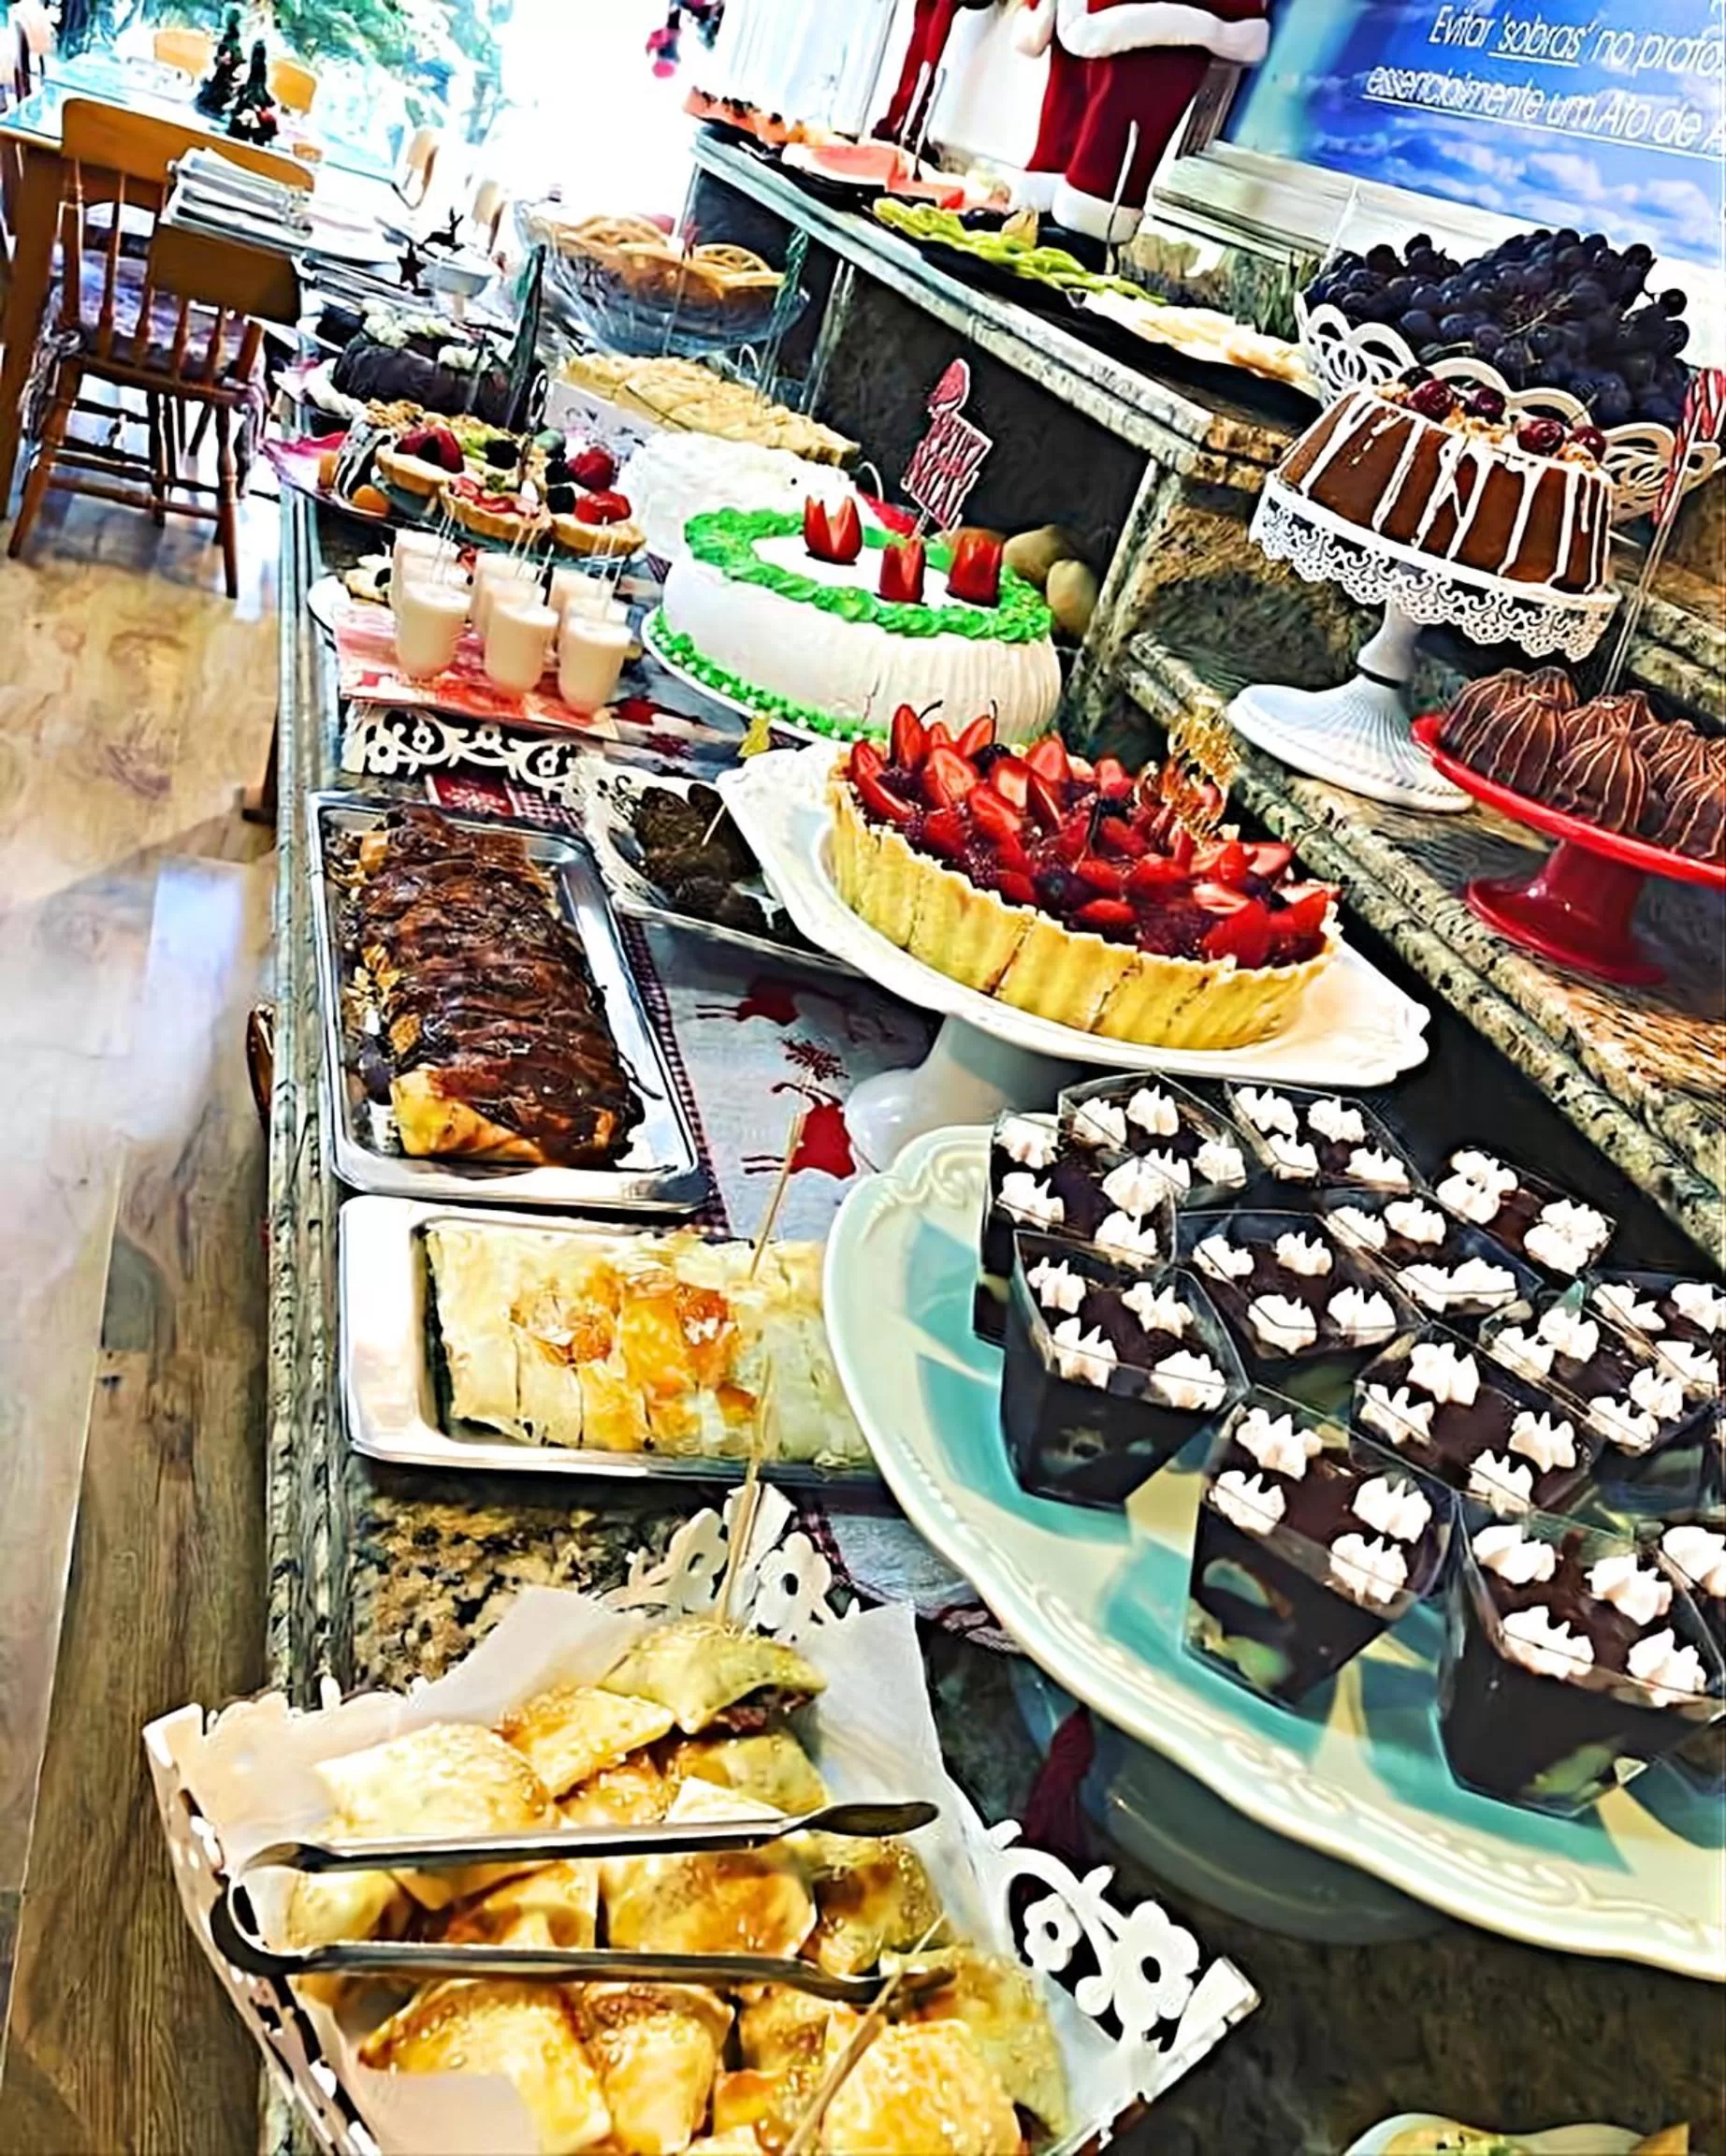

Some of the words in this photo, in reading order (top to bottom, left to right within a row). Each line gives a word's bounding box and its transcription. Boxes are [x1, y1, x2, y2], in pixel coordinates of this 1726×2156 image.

[1429, 5, 1496, 48] Evitar
[1591, 29, 1635, 66] no
[1366, 66, 1545, 119] essencialmente
[1545, 94, 1596, 128] um
[1593, 90, 1651, 139] Ato
[1652, 102, 1703, 148] de
